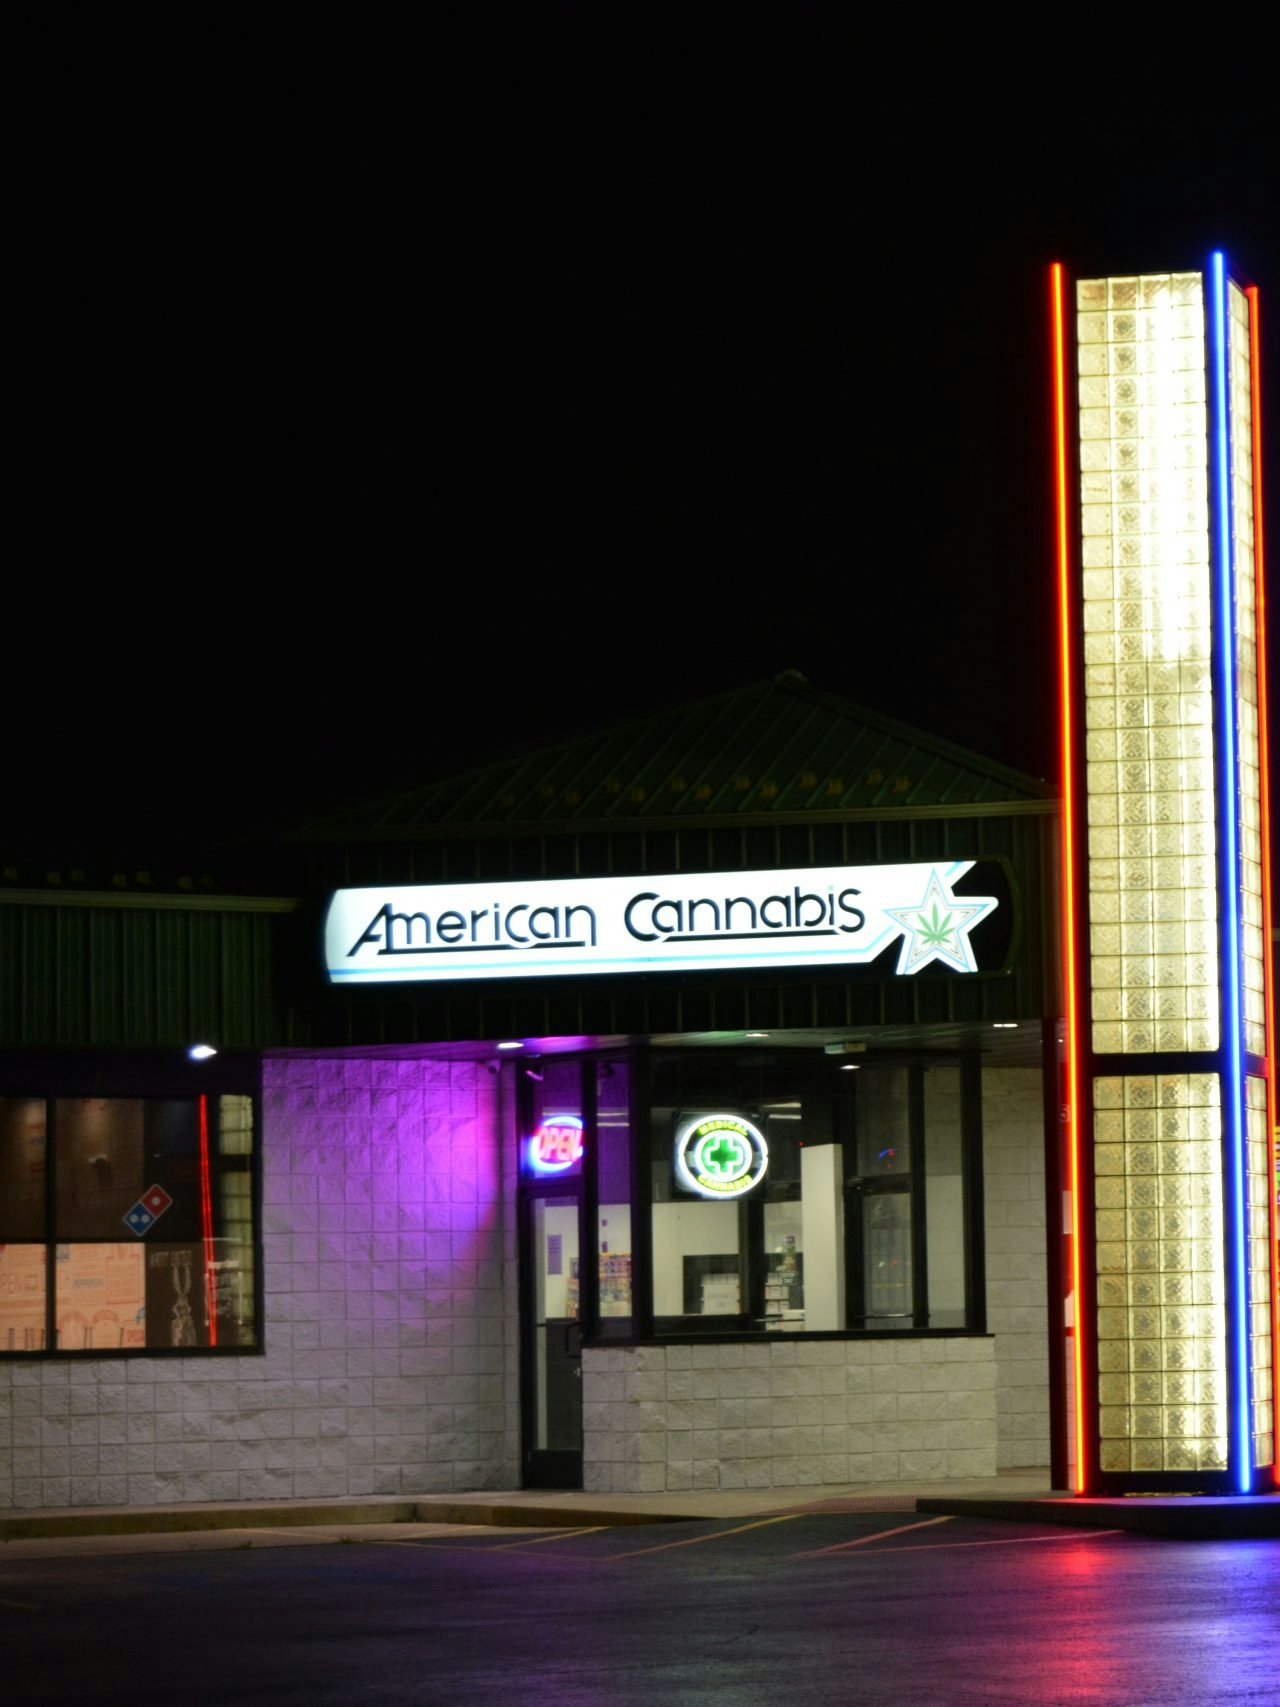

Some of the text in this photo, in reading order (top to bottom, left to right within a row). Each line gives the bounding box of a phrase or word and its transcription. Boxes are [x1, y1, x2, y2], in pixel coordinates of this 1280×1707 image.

[347, 886, 865, 957] American Cannabis
[536, 1126, 583, 1163] OPEN
